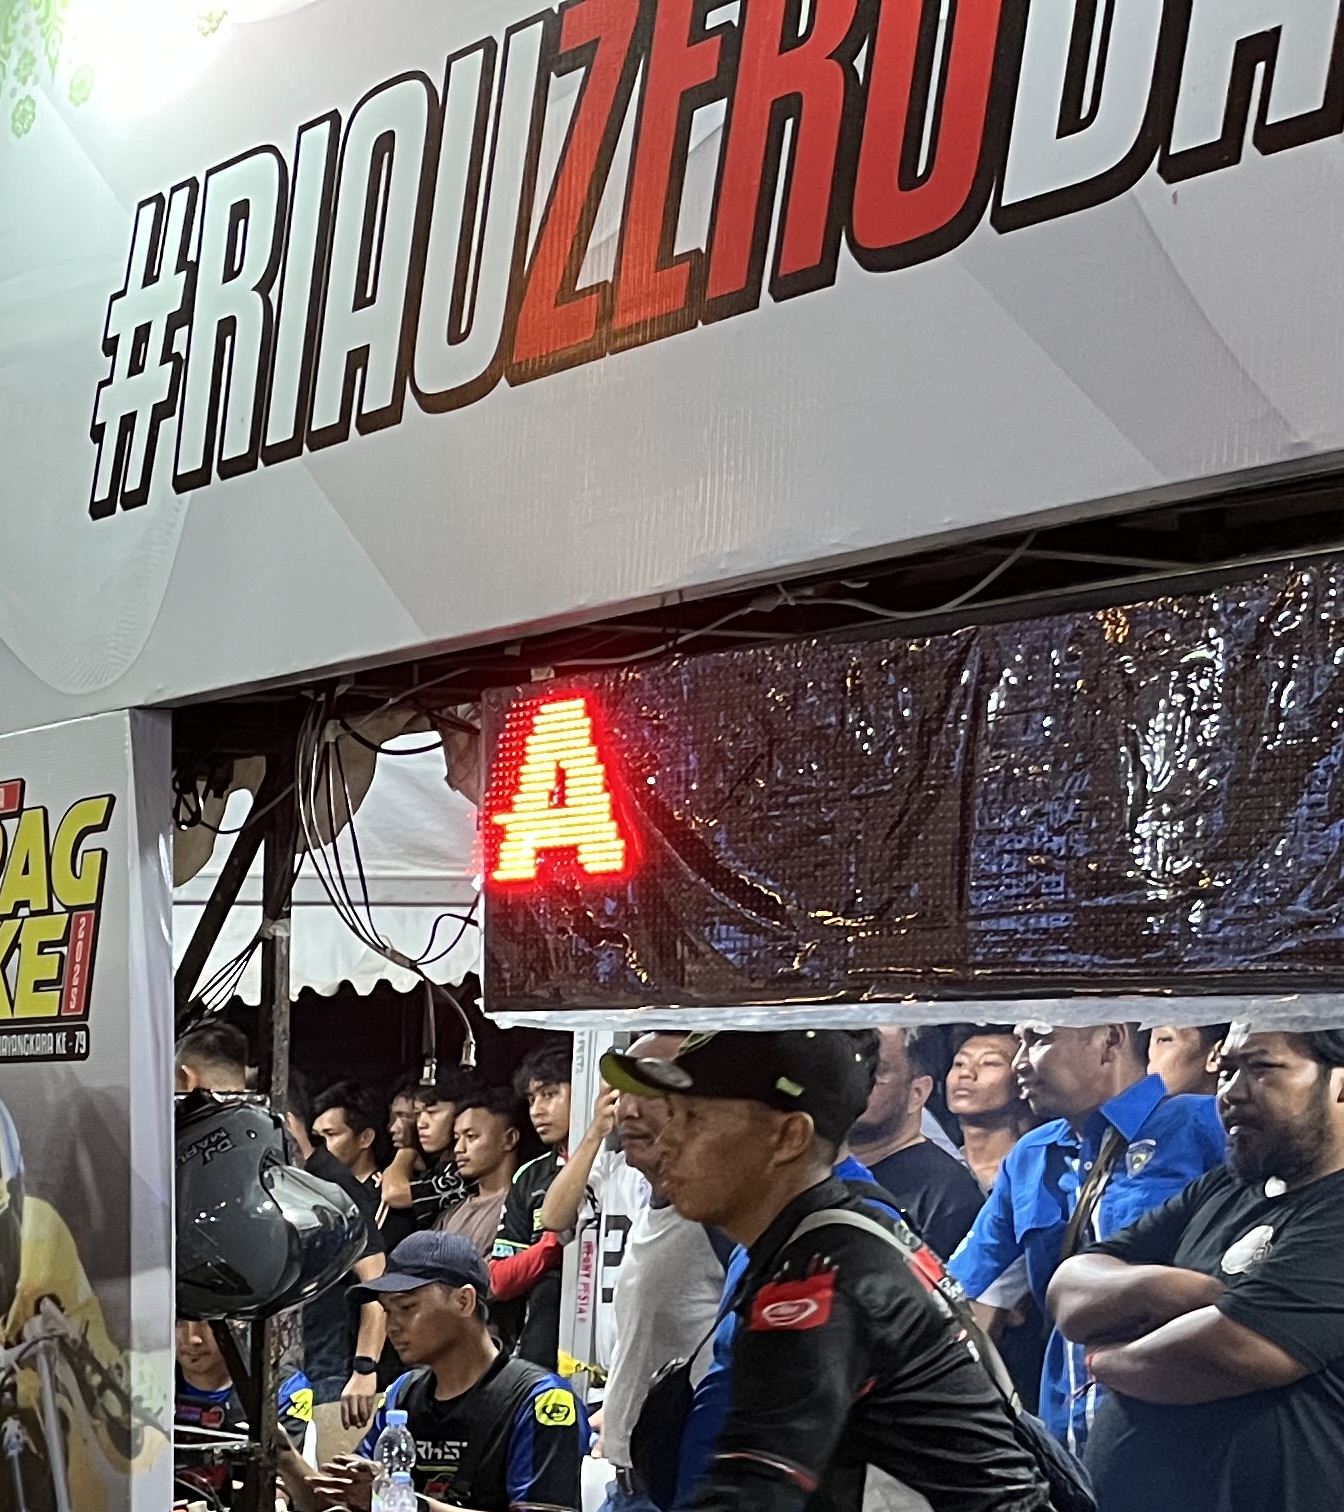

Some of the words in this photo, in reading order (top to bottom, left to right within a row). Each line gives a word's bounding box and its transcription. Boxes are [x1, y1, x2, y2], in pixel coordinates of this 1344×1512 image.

[492, 697, 627, 881] A
[68, 916, 88, 1011] 2025
[55, 1031, 67, 1055] KE
[74, 1030, 87, 1055] 79
